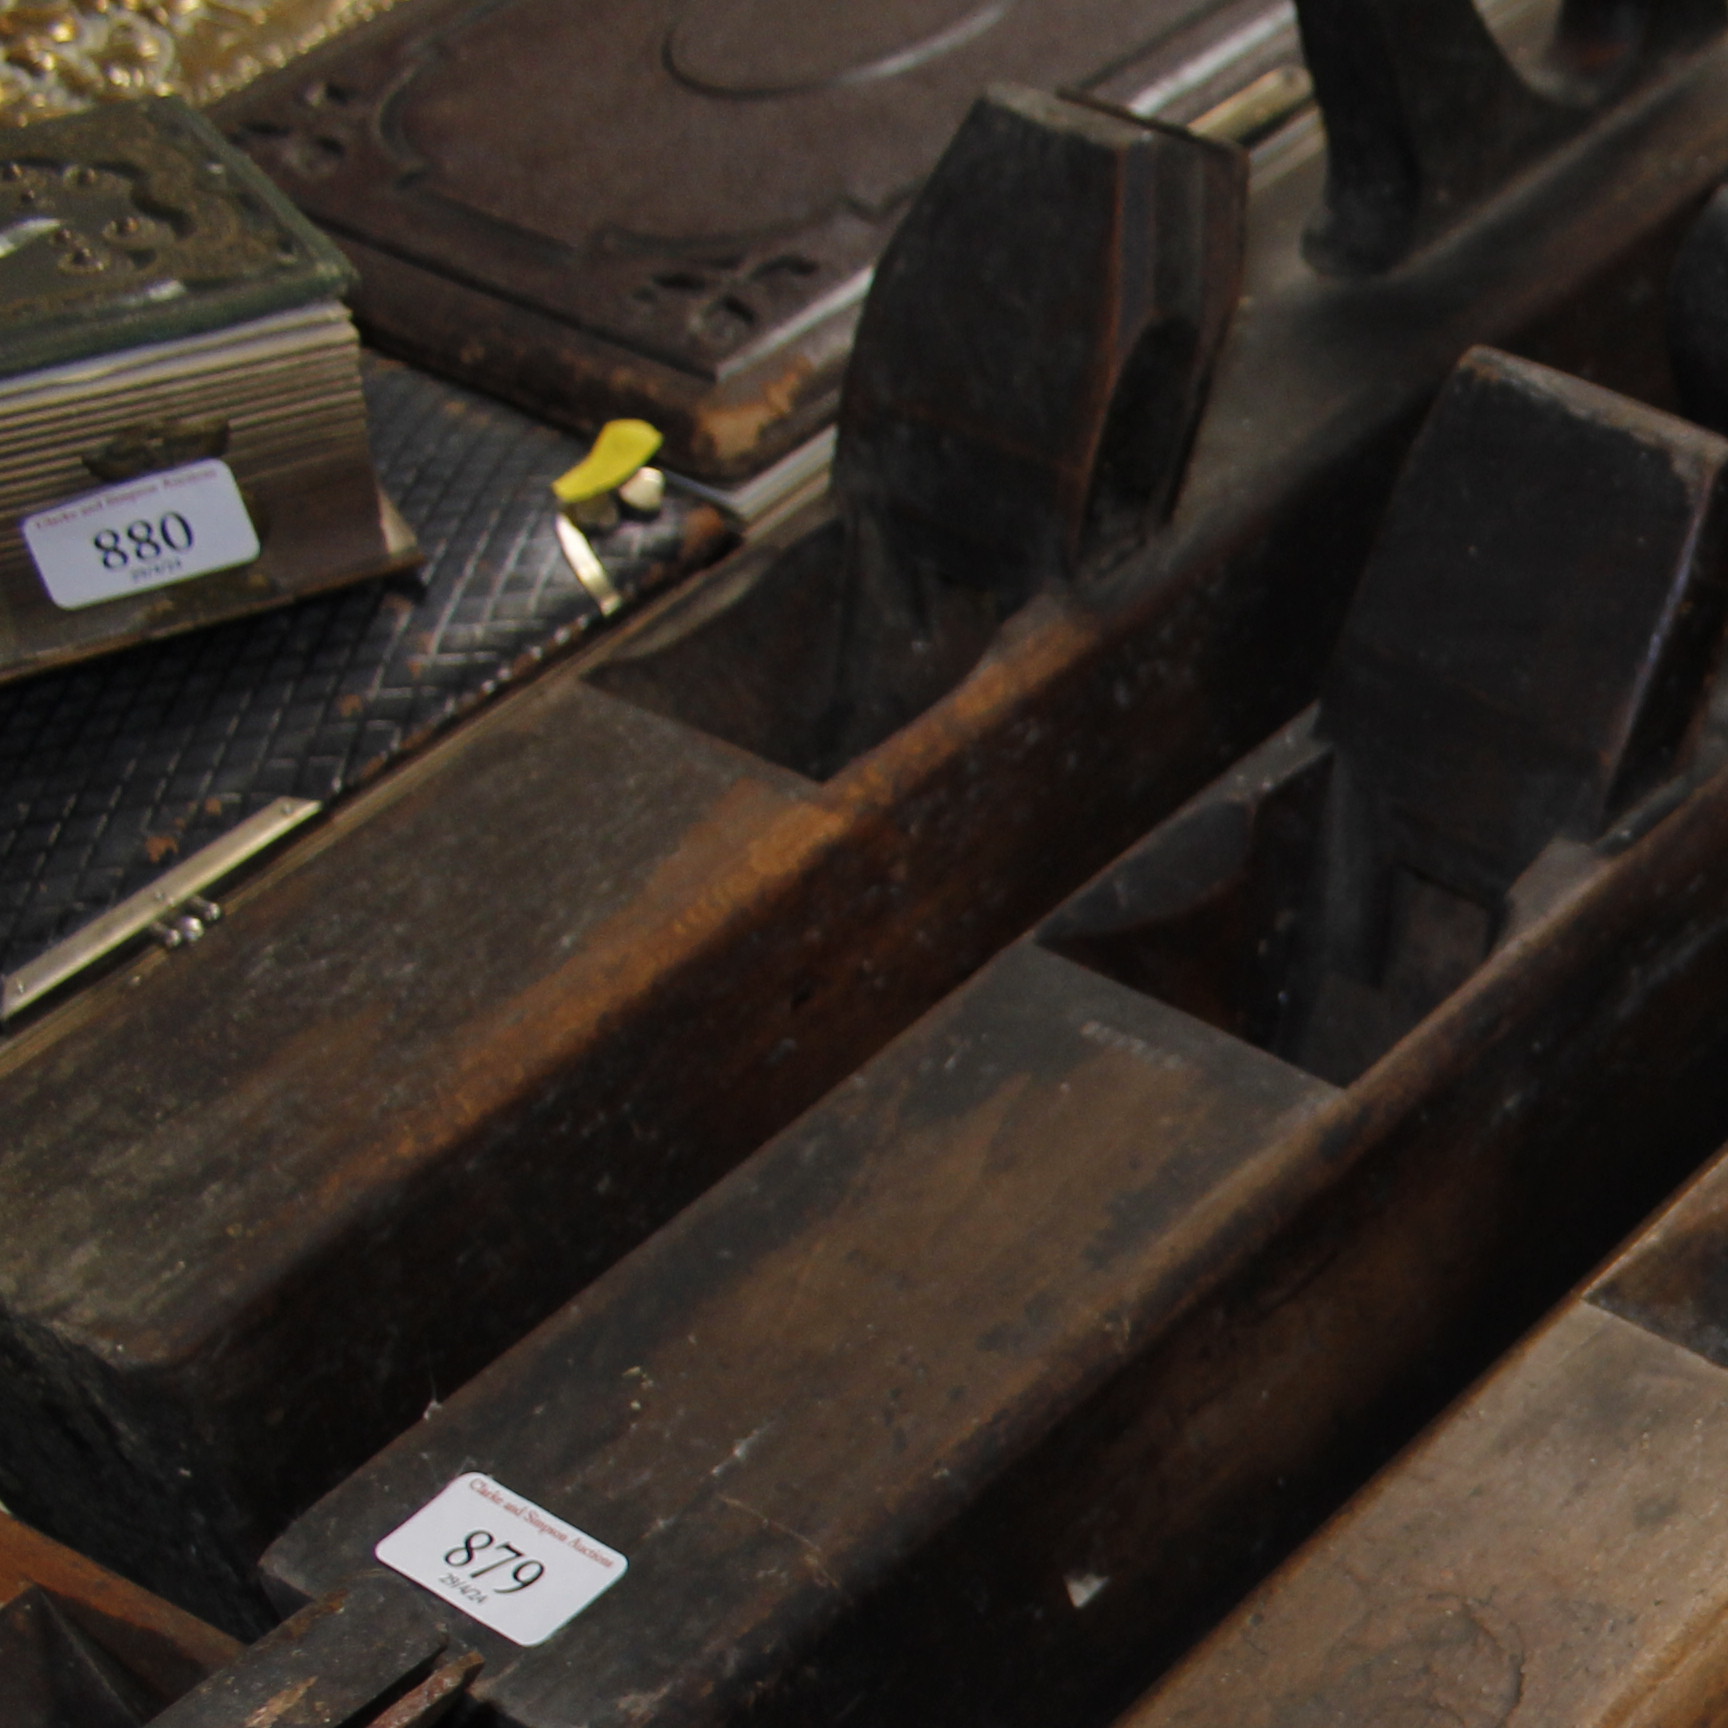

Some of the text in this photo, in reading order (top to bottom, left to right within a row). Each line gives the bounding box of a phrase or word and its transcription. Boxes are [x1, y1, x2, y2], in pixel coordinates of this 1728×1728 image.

[93, 511, 194, 570] 880
[468, 1477, 615, 1569] Clarke and Simpson Auctions
[438, 1572, 489, 1606] 29/4/24
[443, 1529, 545, 1596] 879
